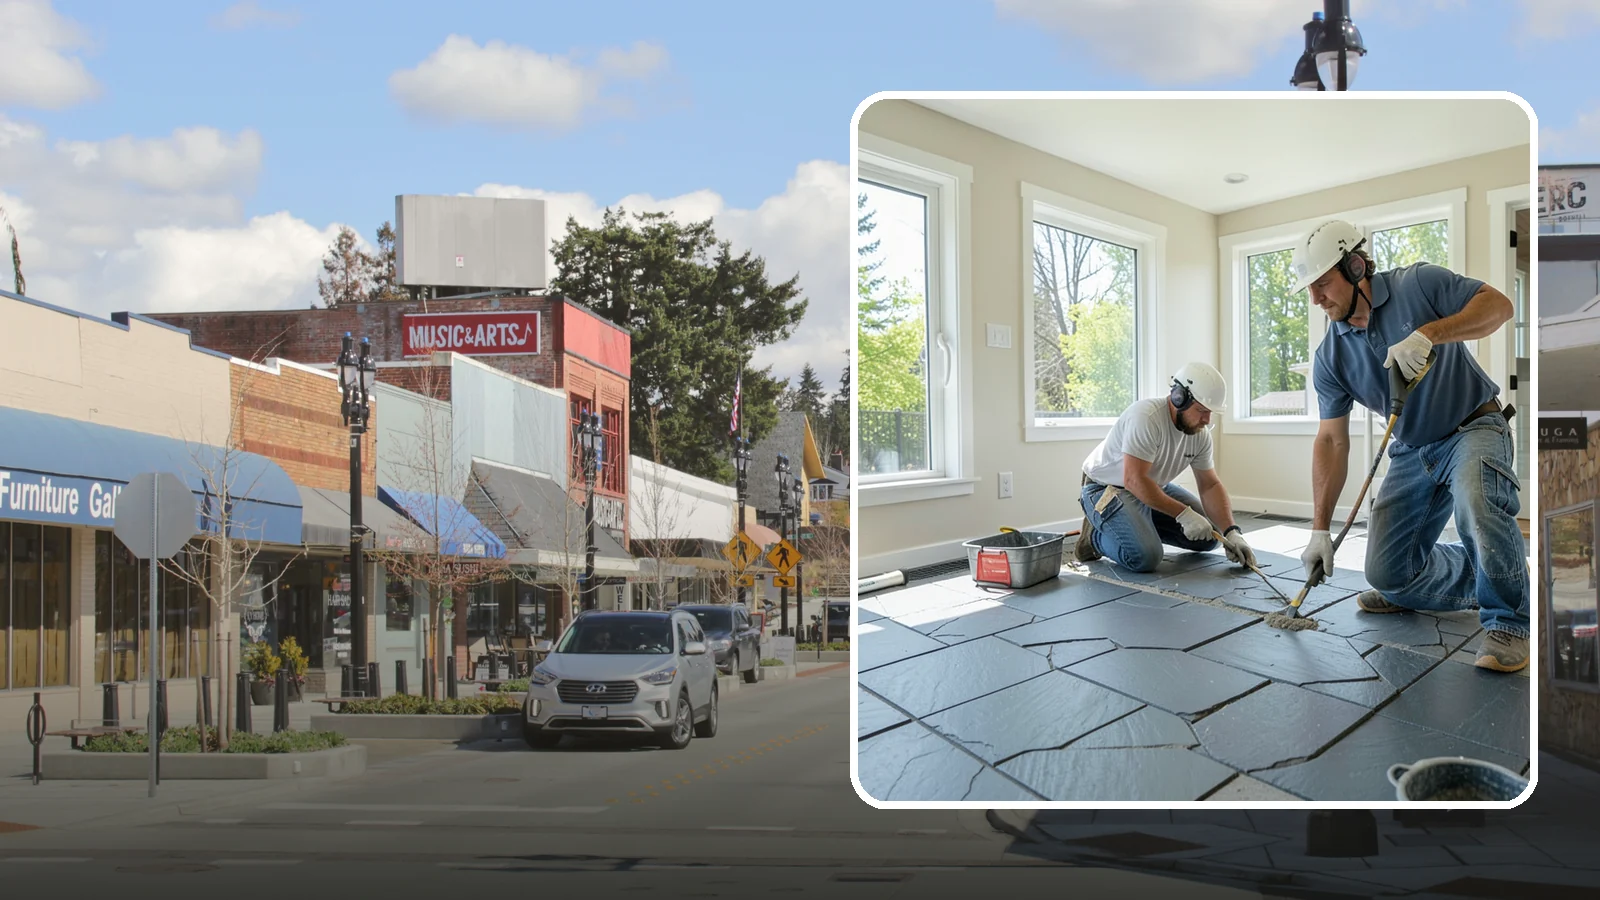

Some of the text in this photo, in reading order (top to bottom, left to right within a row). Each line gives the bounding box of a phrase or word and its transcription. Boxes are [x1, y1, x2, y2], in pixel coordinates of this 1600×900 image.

[409, 322, 520, 349] MUSIC&ARTS
[1540, 427, 1578, 437] UGA
[0, 471, 122, 519] Furniture Gal
[453, 563, 480, 575] SUSHI
